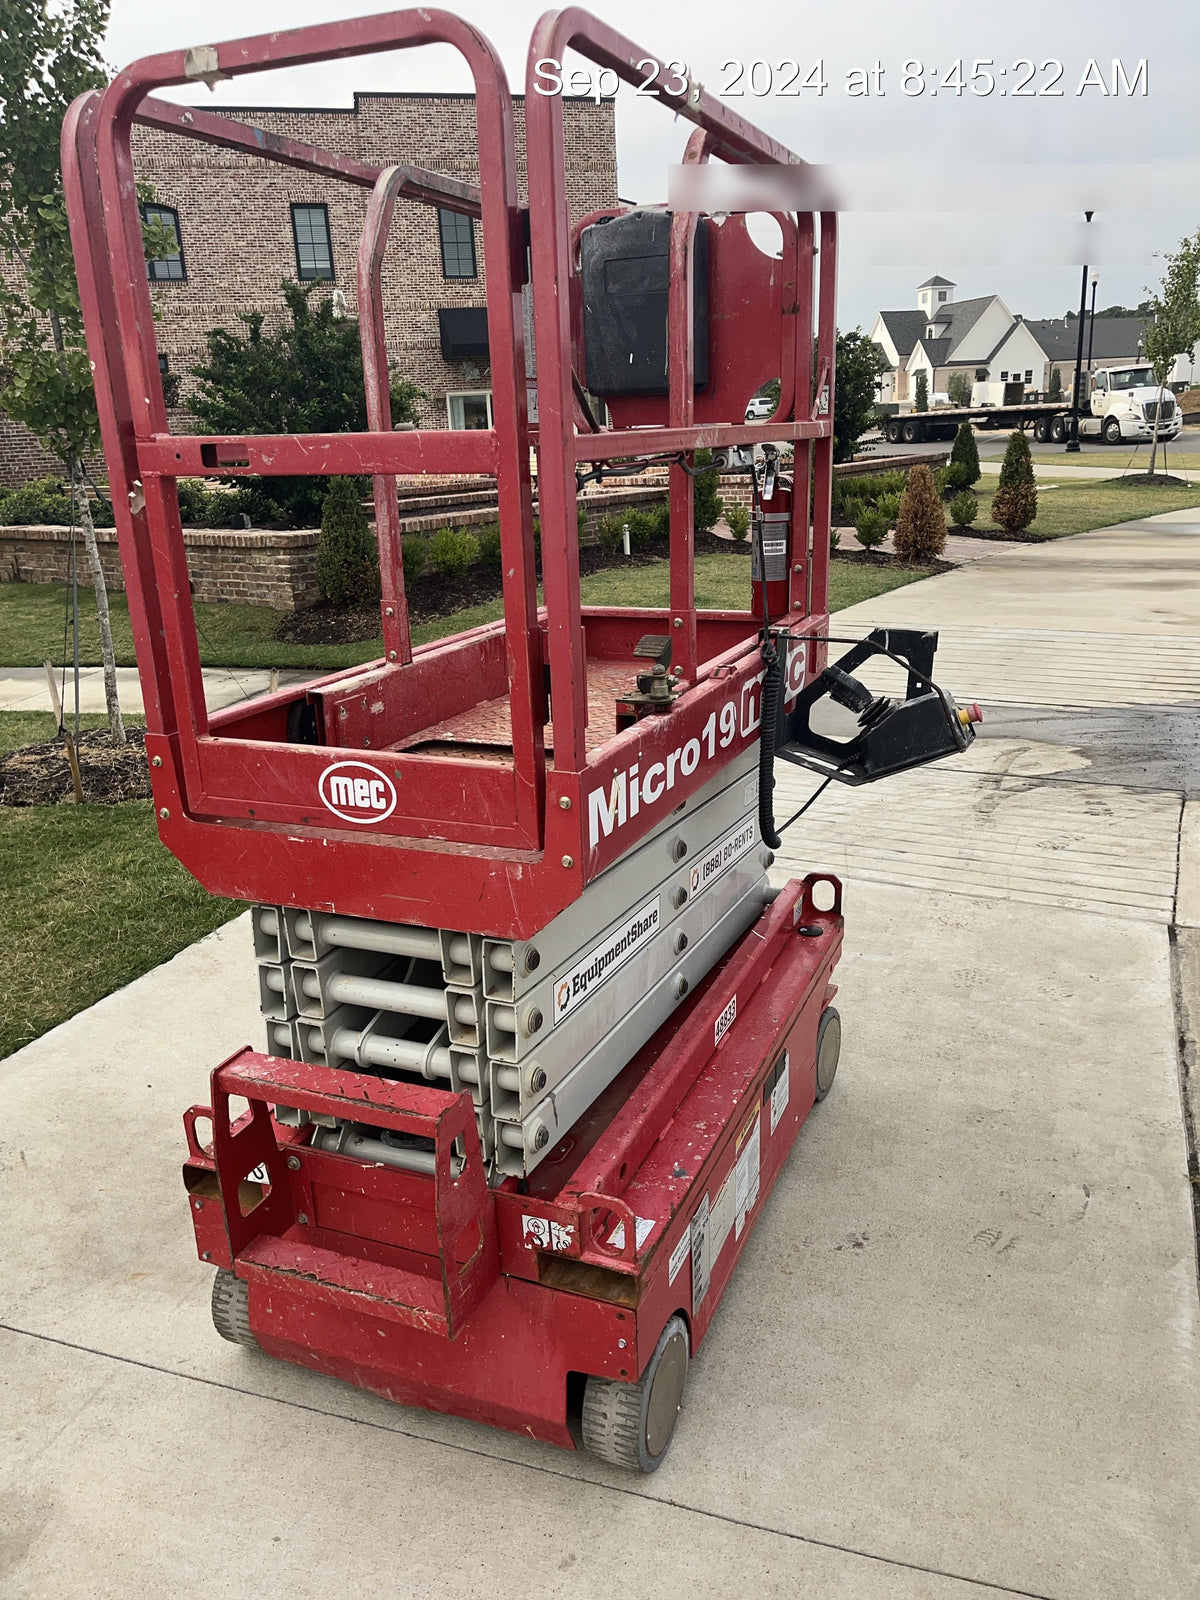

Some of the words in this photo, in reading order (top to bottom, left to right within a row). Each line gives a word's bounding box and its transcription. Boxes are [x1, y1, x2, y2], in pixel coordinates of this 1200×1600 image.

[588, 701, 736, 849] Micro19
[702, 850, 722, 880] (888)
[723, 825, 753, 861] 80-RENTS
[571, 908, 659, 998] EquipmentShare
[715, 999, 736, 1037] 48833
